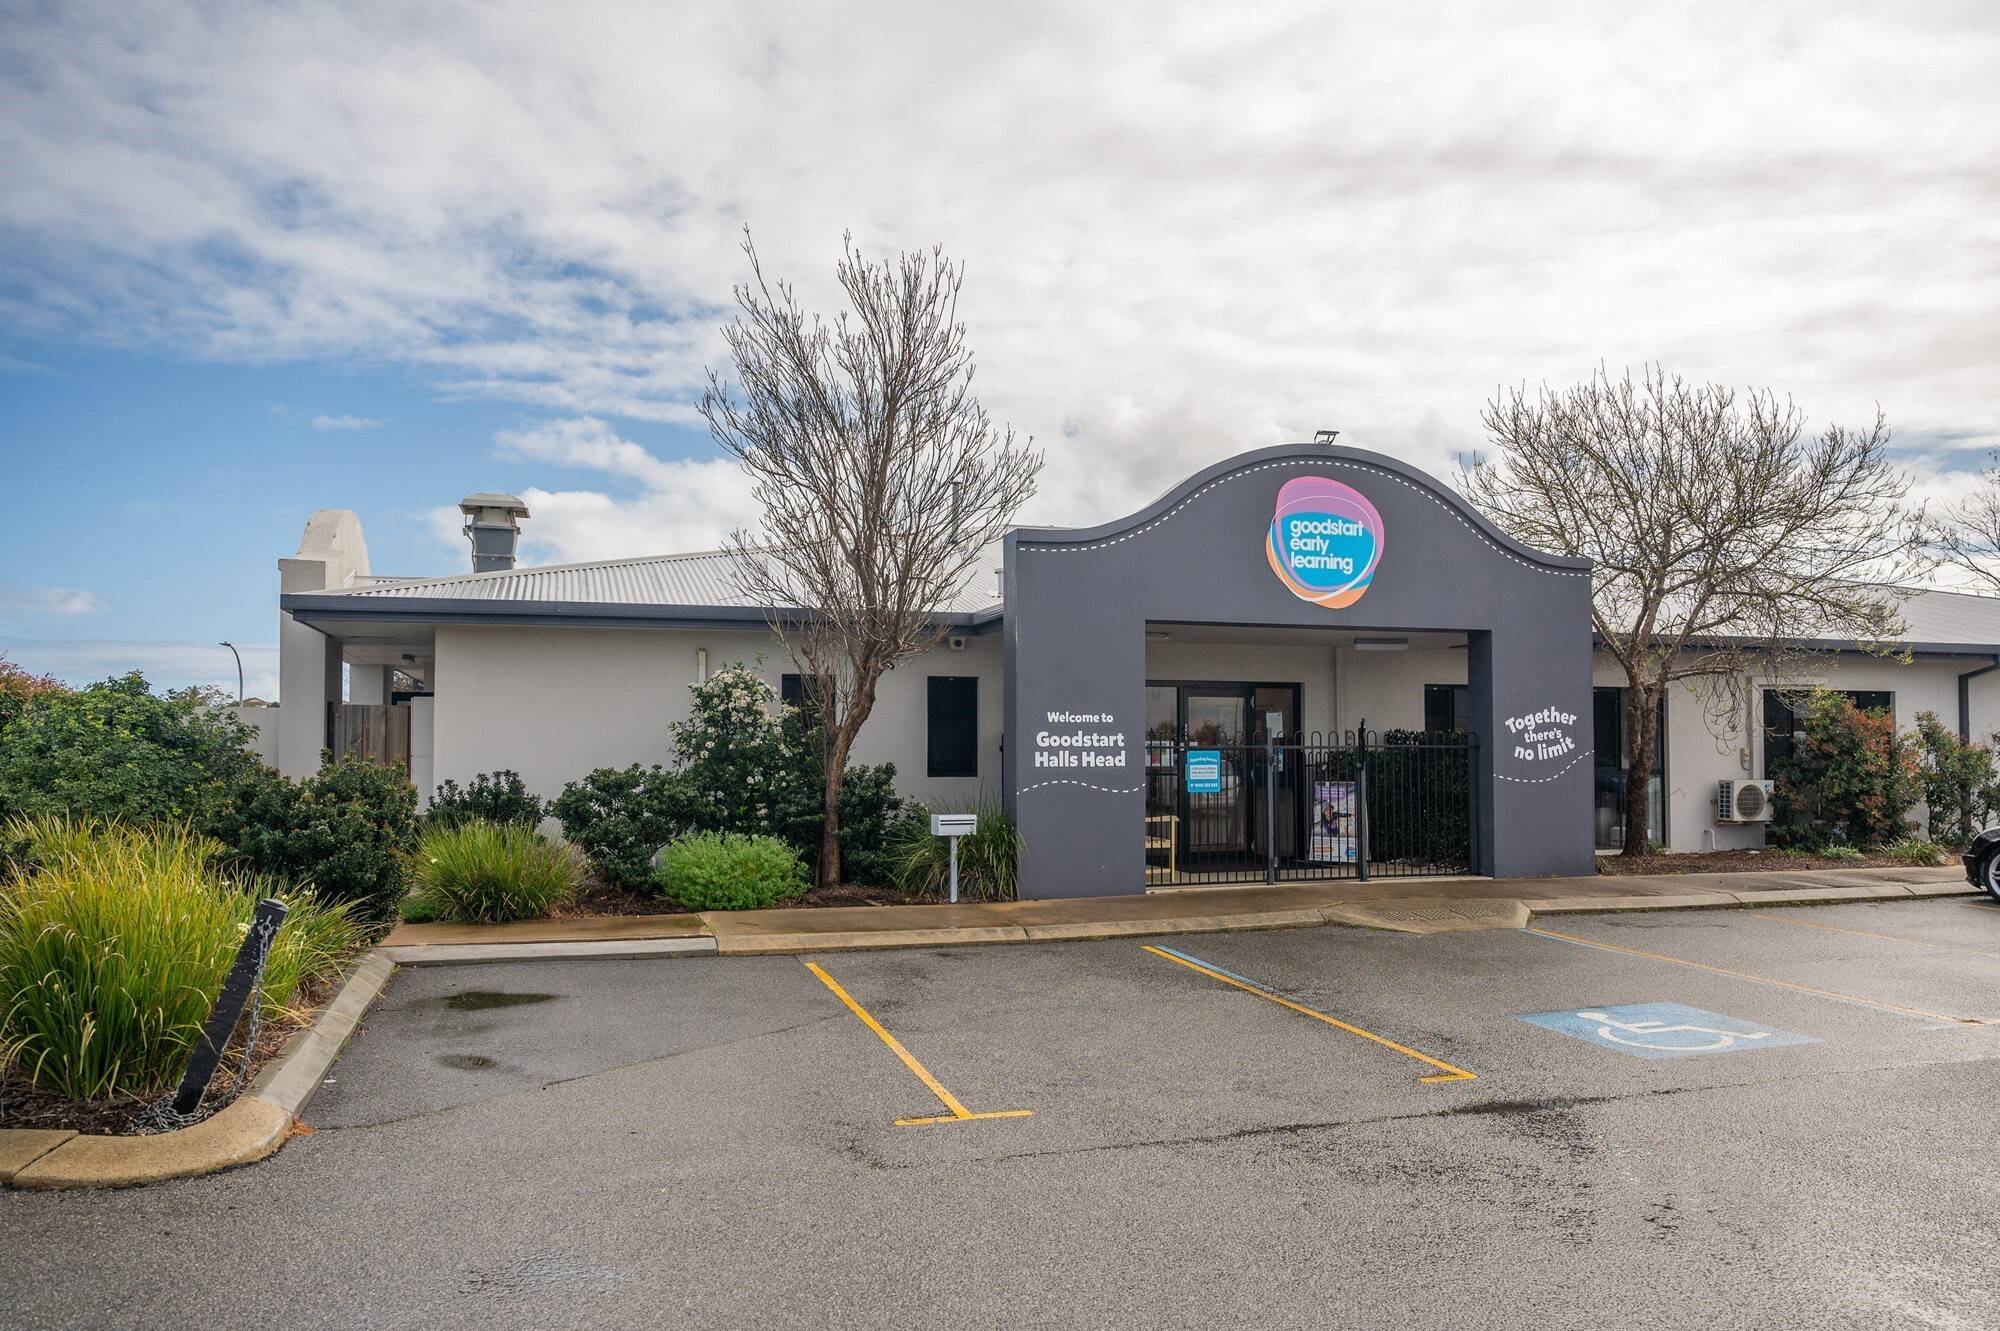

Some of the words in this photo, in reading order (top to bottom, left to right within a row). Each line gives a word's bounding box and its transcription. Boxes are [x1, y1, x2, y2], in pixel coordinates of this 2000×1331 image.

[1290, 519, 1364, 537] goodstart
[1290, 535, 1329, 555] early
[1290, 551, 1353, 574] learning
[1047, 711, 1100, 723] Welcome
[1101, 712, 1114, 723] to
[1504, 706, 1577, 734] Together
[1036, 730, 1125, 747] Goodstart
[1523, 727, 1563, 743] there's
[1513, 746, 1535, 761] no
[1538, 736, 1576, 760] limit
[1034, 750, 1079, 768] Halls
[1081, 750, 1126, 768] Head
